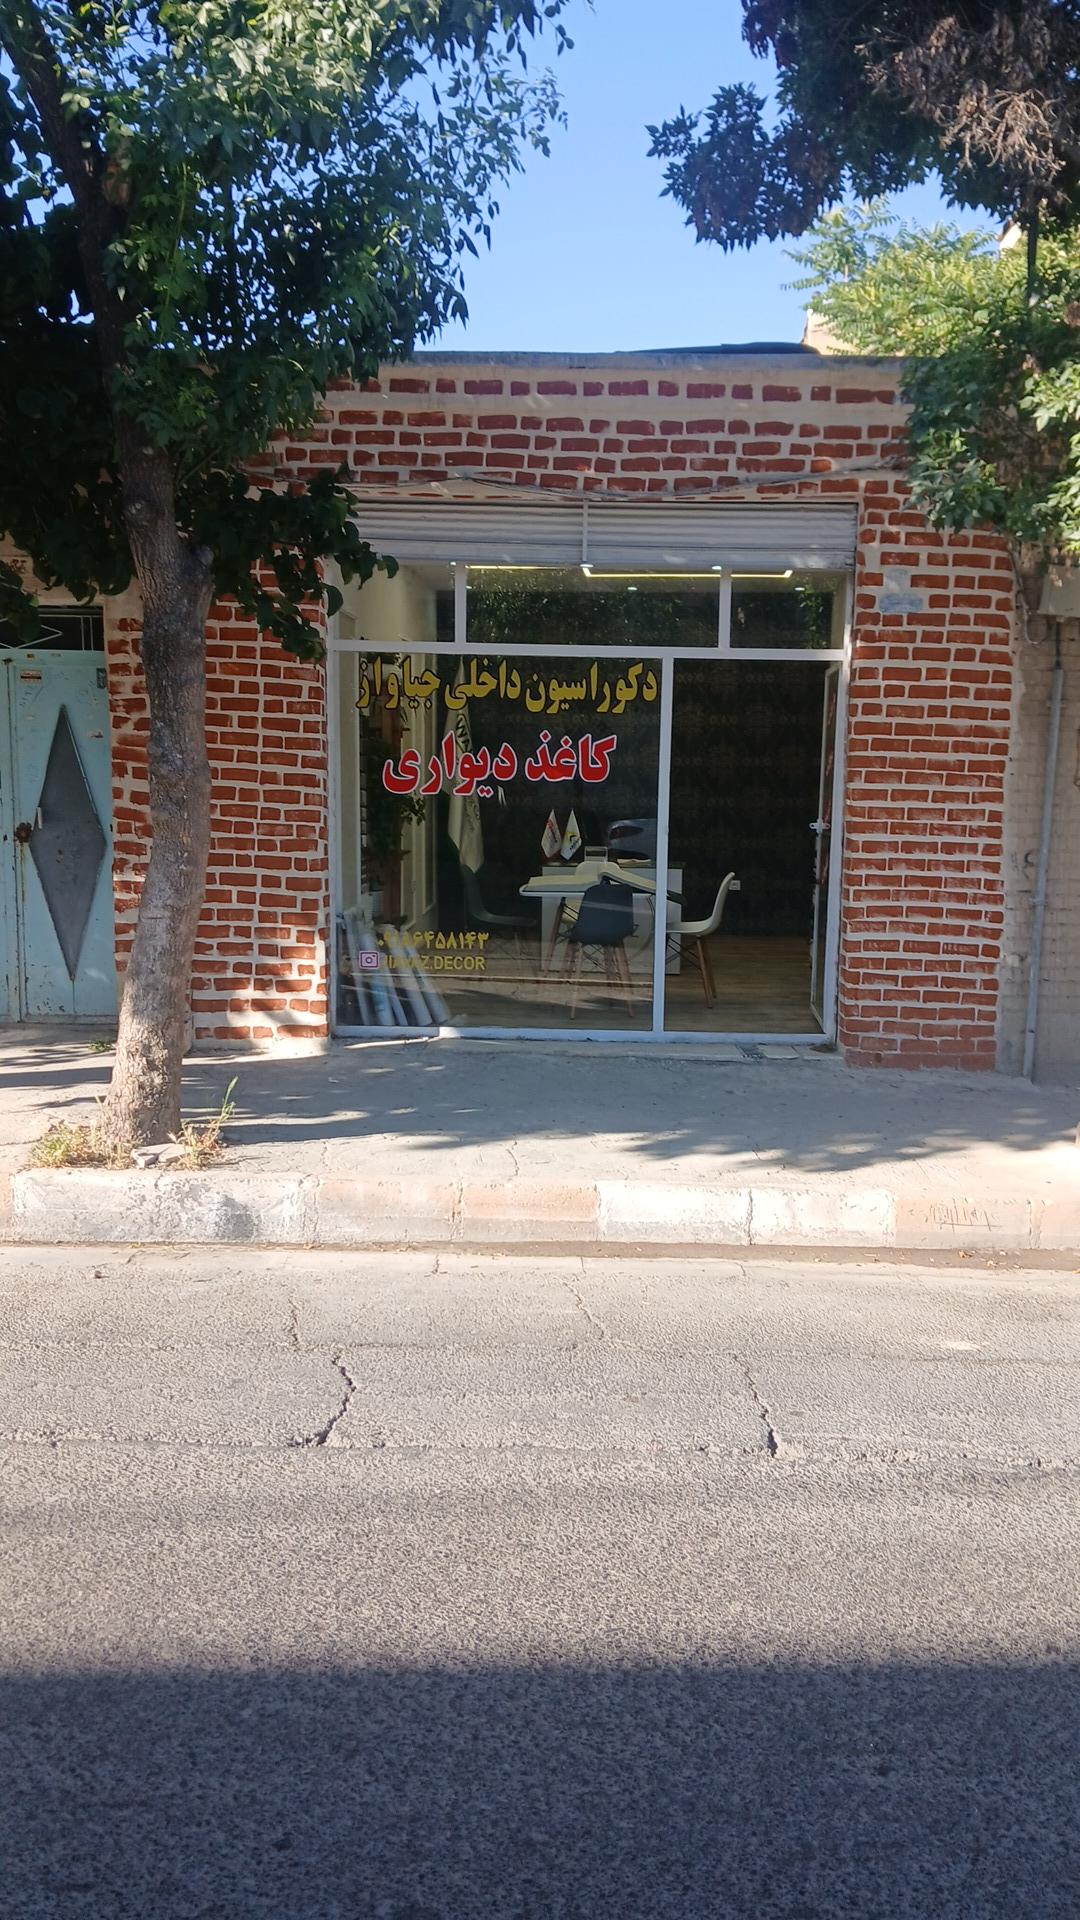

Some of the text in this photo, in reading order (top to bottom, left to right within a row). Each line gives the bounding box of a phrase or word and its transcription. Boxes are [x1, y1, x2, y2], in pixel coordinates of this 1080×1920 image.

[444, 657, 521, 709] داخلی
[525, 660, 658, 714] دکوراسیون
[382, 730, 518, 798] دیواری
[524, 729, 618, 783] کاغذ
